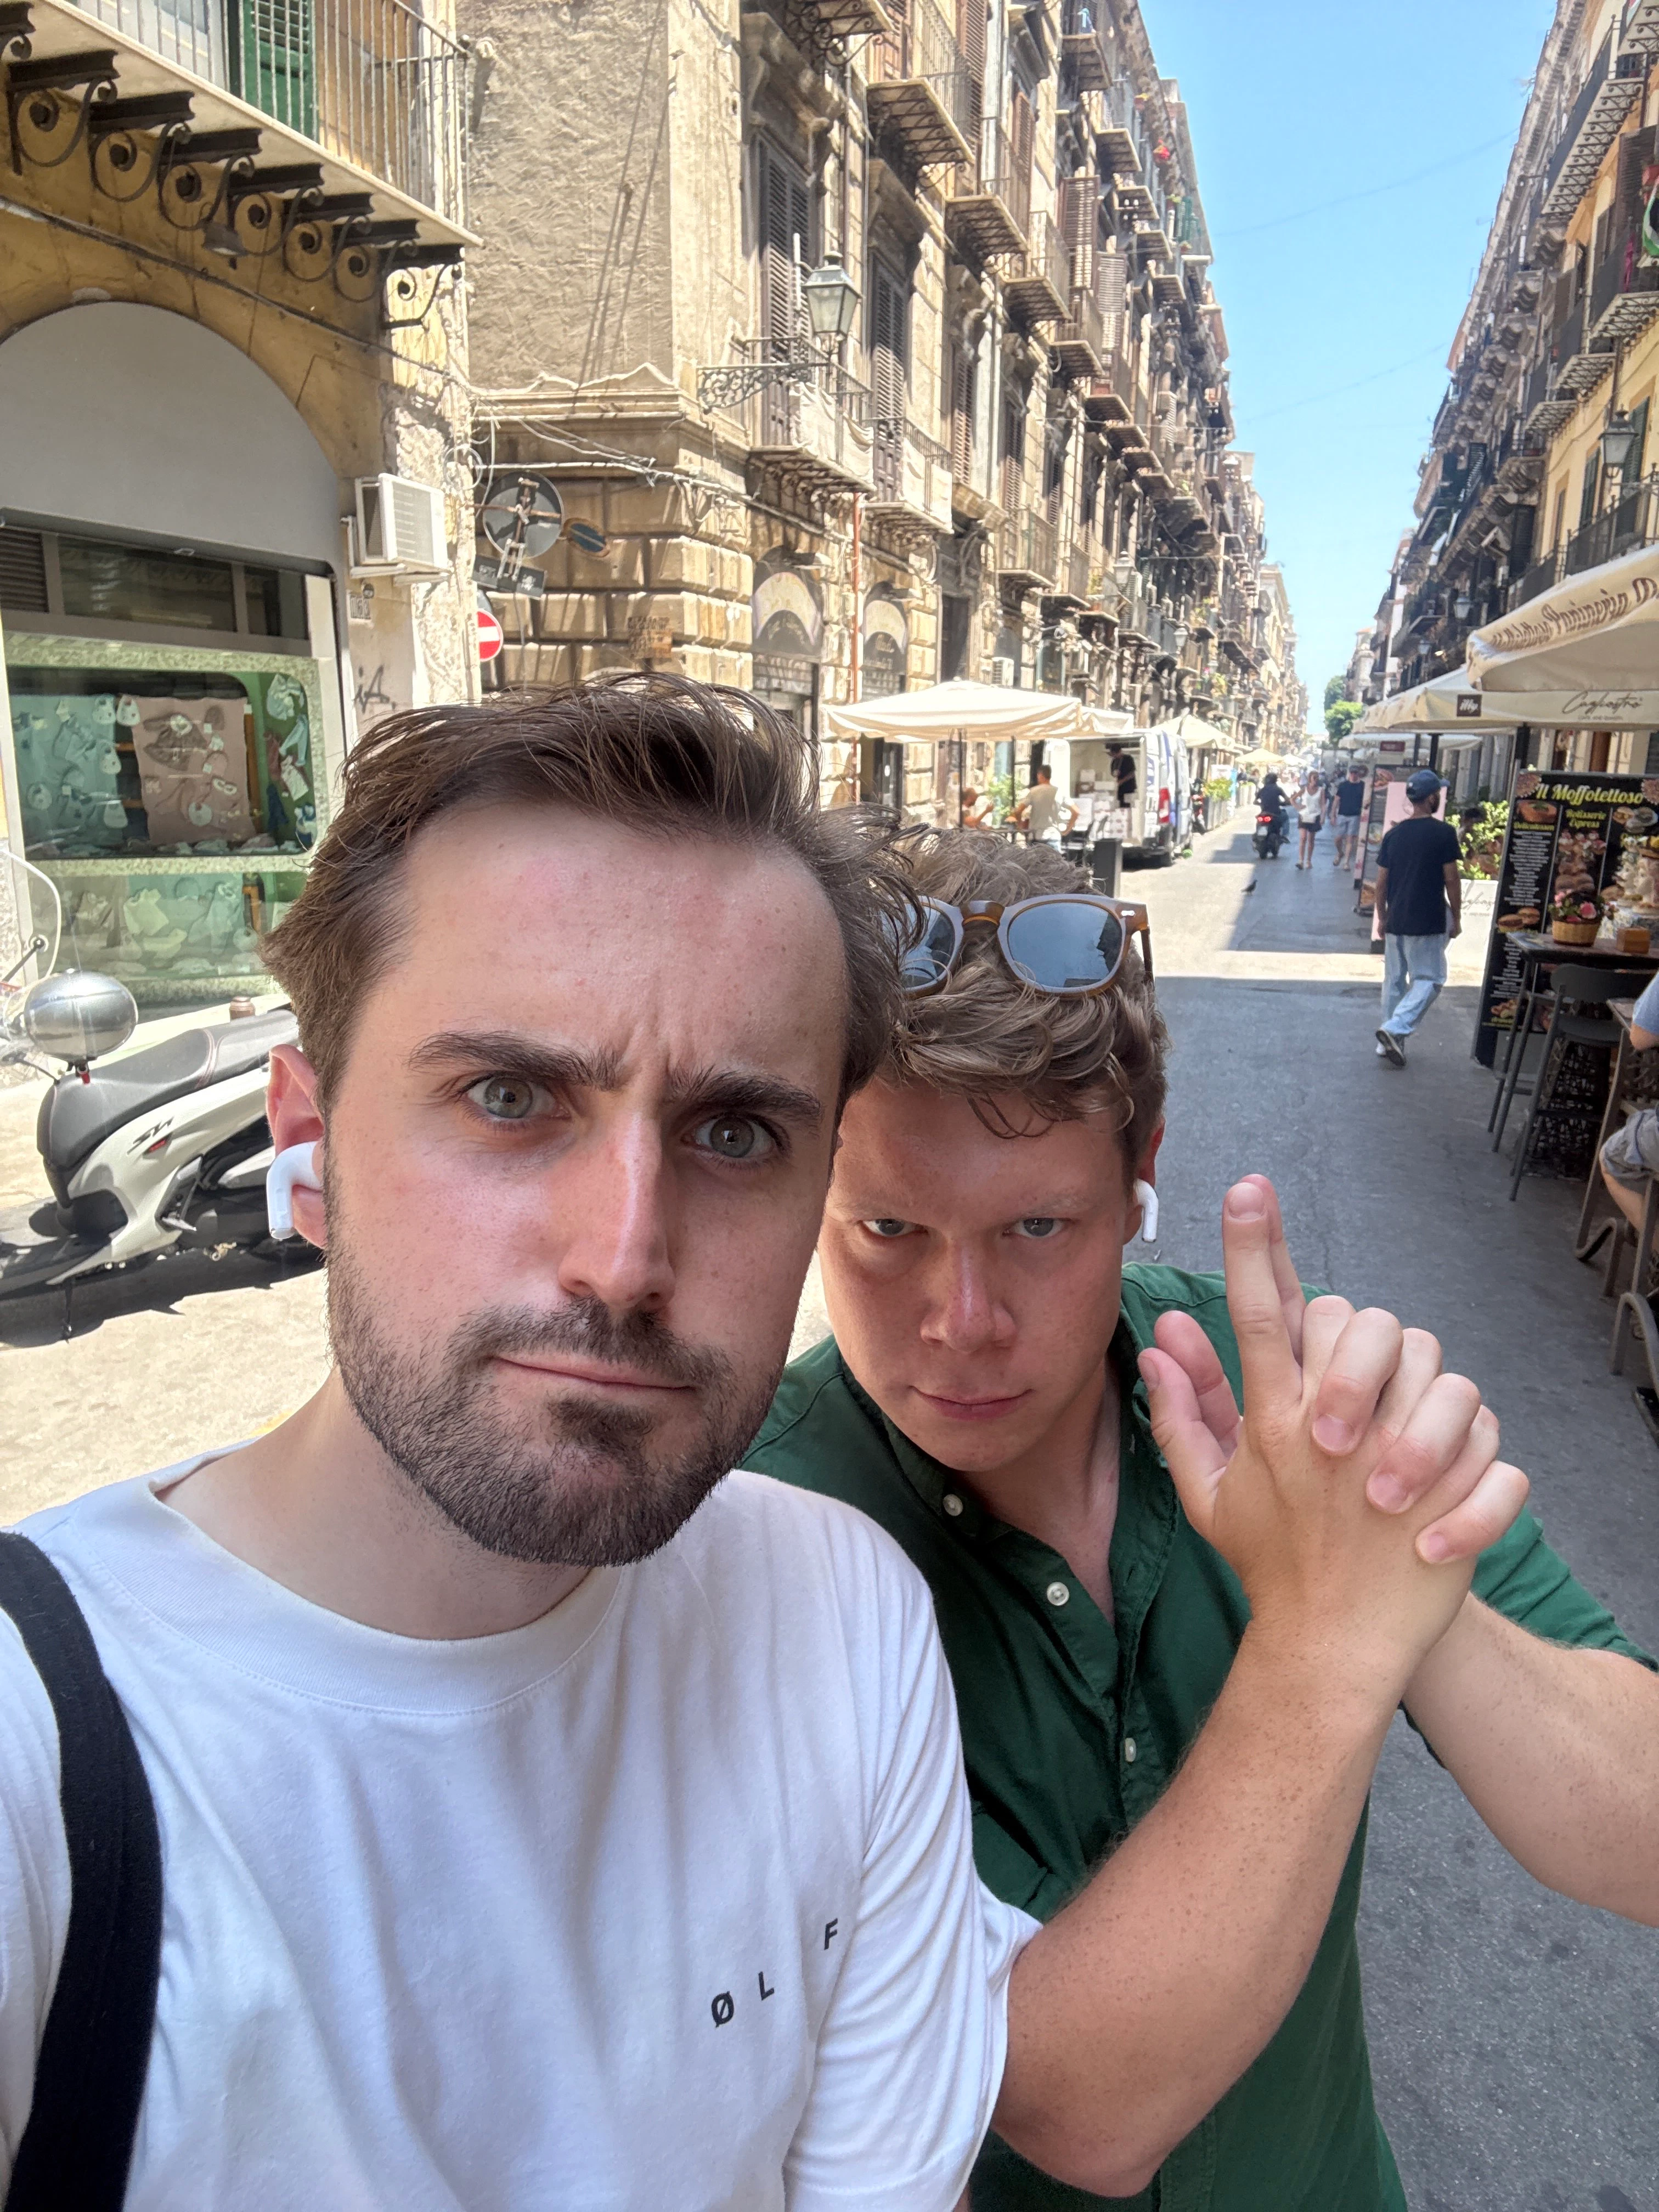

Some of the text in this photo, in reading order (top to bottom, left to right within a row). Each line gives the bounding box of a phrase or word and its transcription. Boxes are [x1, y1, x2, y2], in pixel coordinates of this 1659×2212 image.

[1536, 783, 1644, 806] Il Moffolettoso
[758, 1971, 775, 2001] L
[824, 1918, 838, 1950] F
